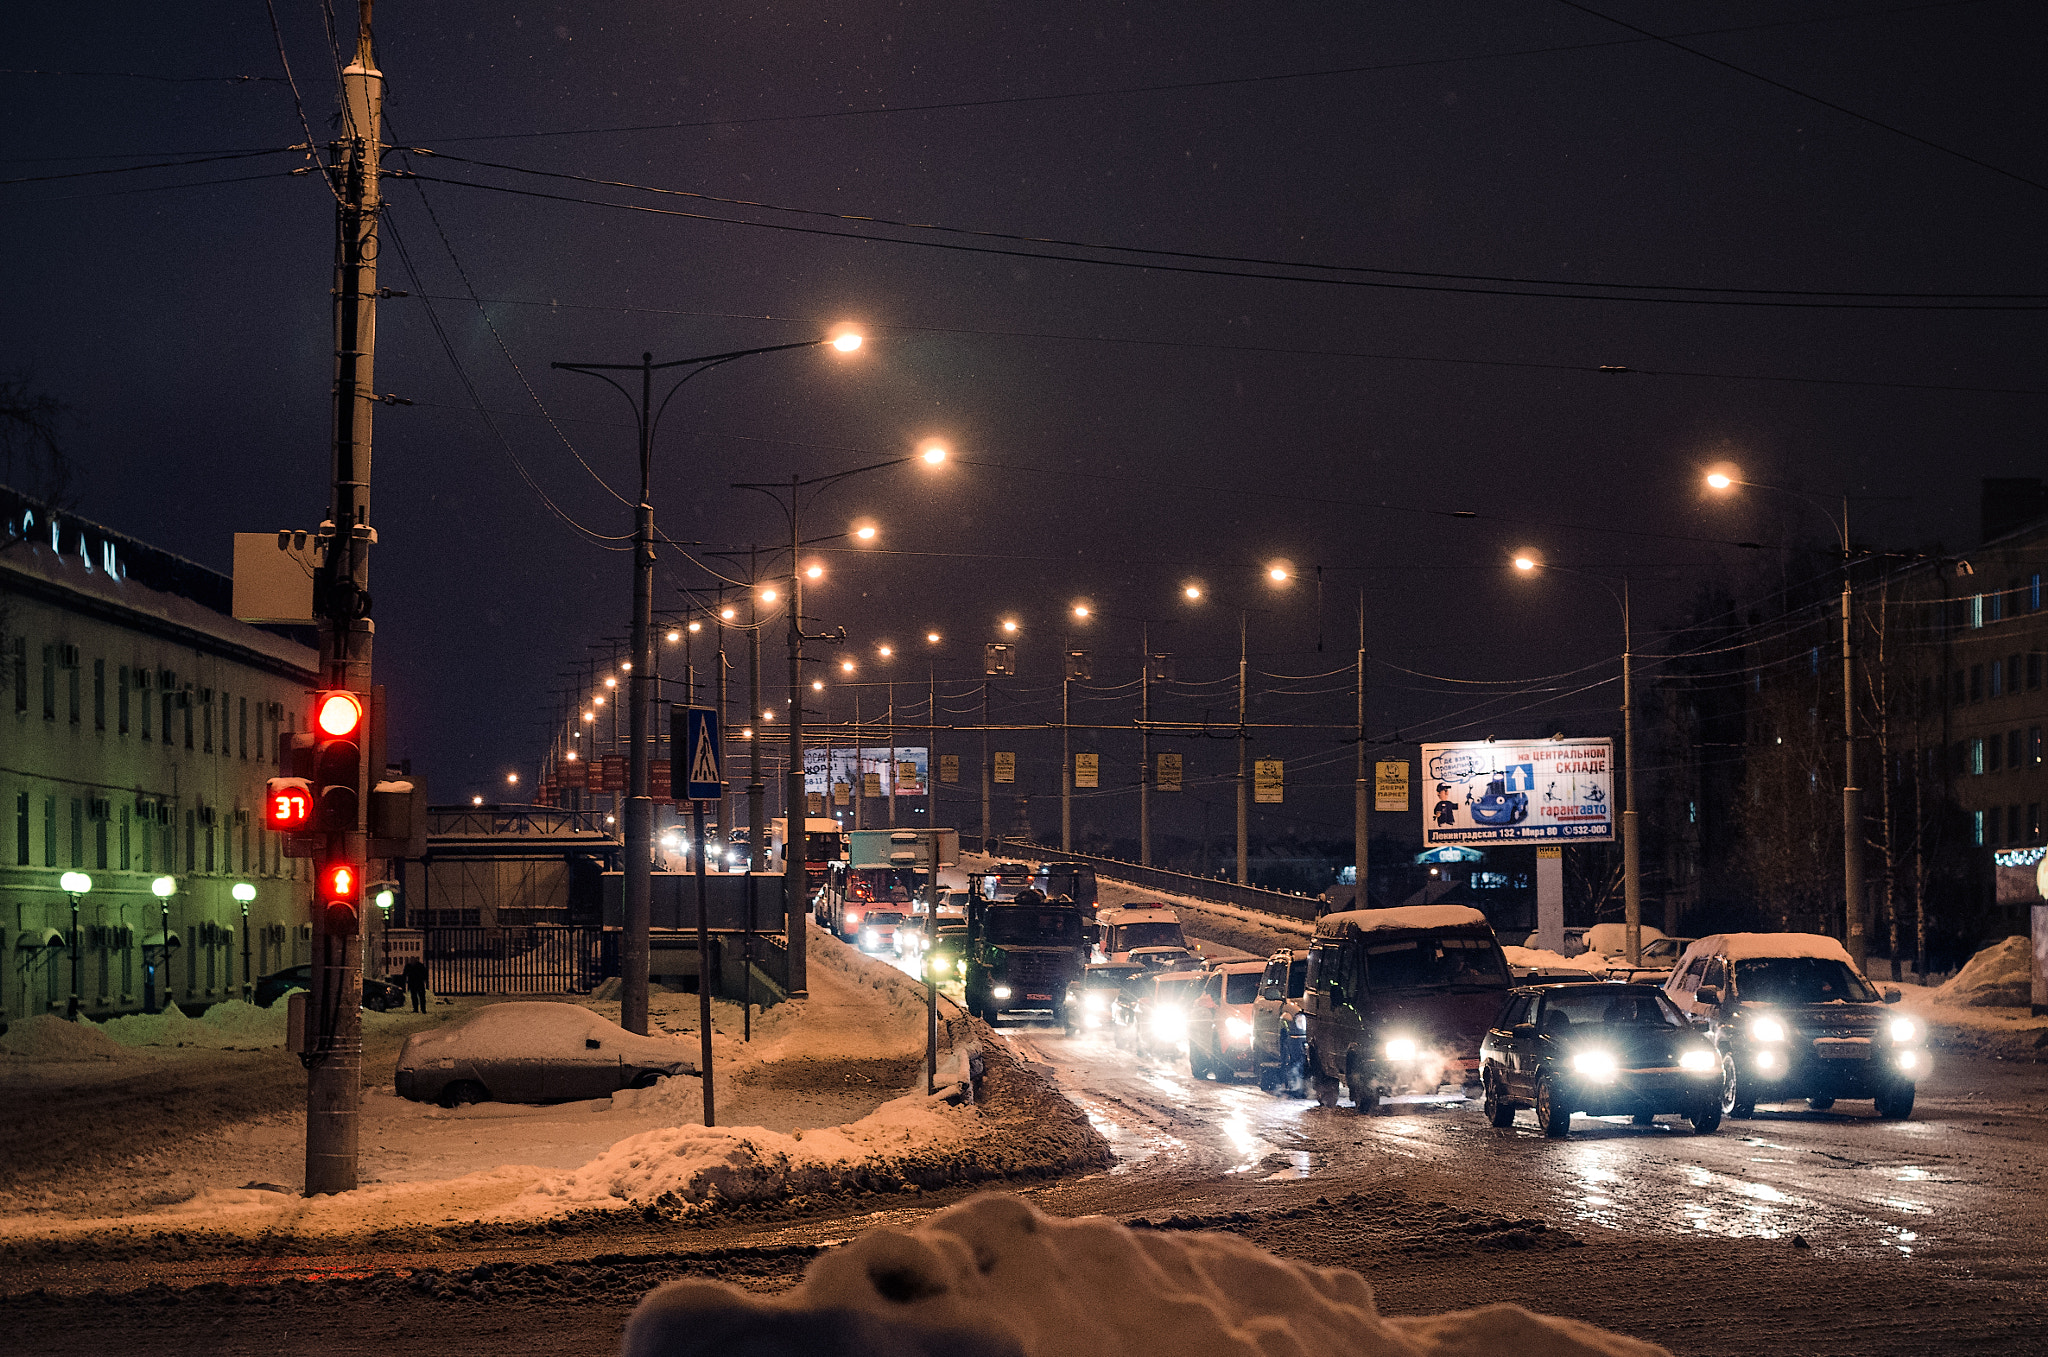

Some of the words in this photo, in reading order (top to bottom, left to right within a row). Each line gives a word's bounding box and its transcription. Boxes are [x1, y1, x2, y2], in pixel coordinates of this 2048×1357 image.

[1532, 749, 1605, 761] ЦЕНТРАЛЬНОМ
[1556, 760, 1605, 774] СКЛАДЕ
[275, 796, 305, 819] 37
[1540, 804, 1607, 818] гарантавто
[1431, 830, 1497, 842] Ленинградская
[1499, 829, 1515, 838] 132
[1521, 827, 1545, 837] Мира
